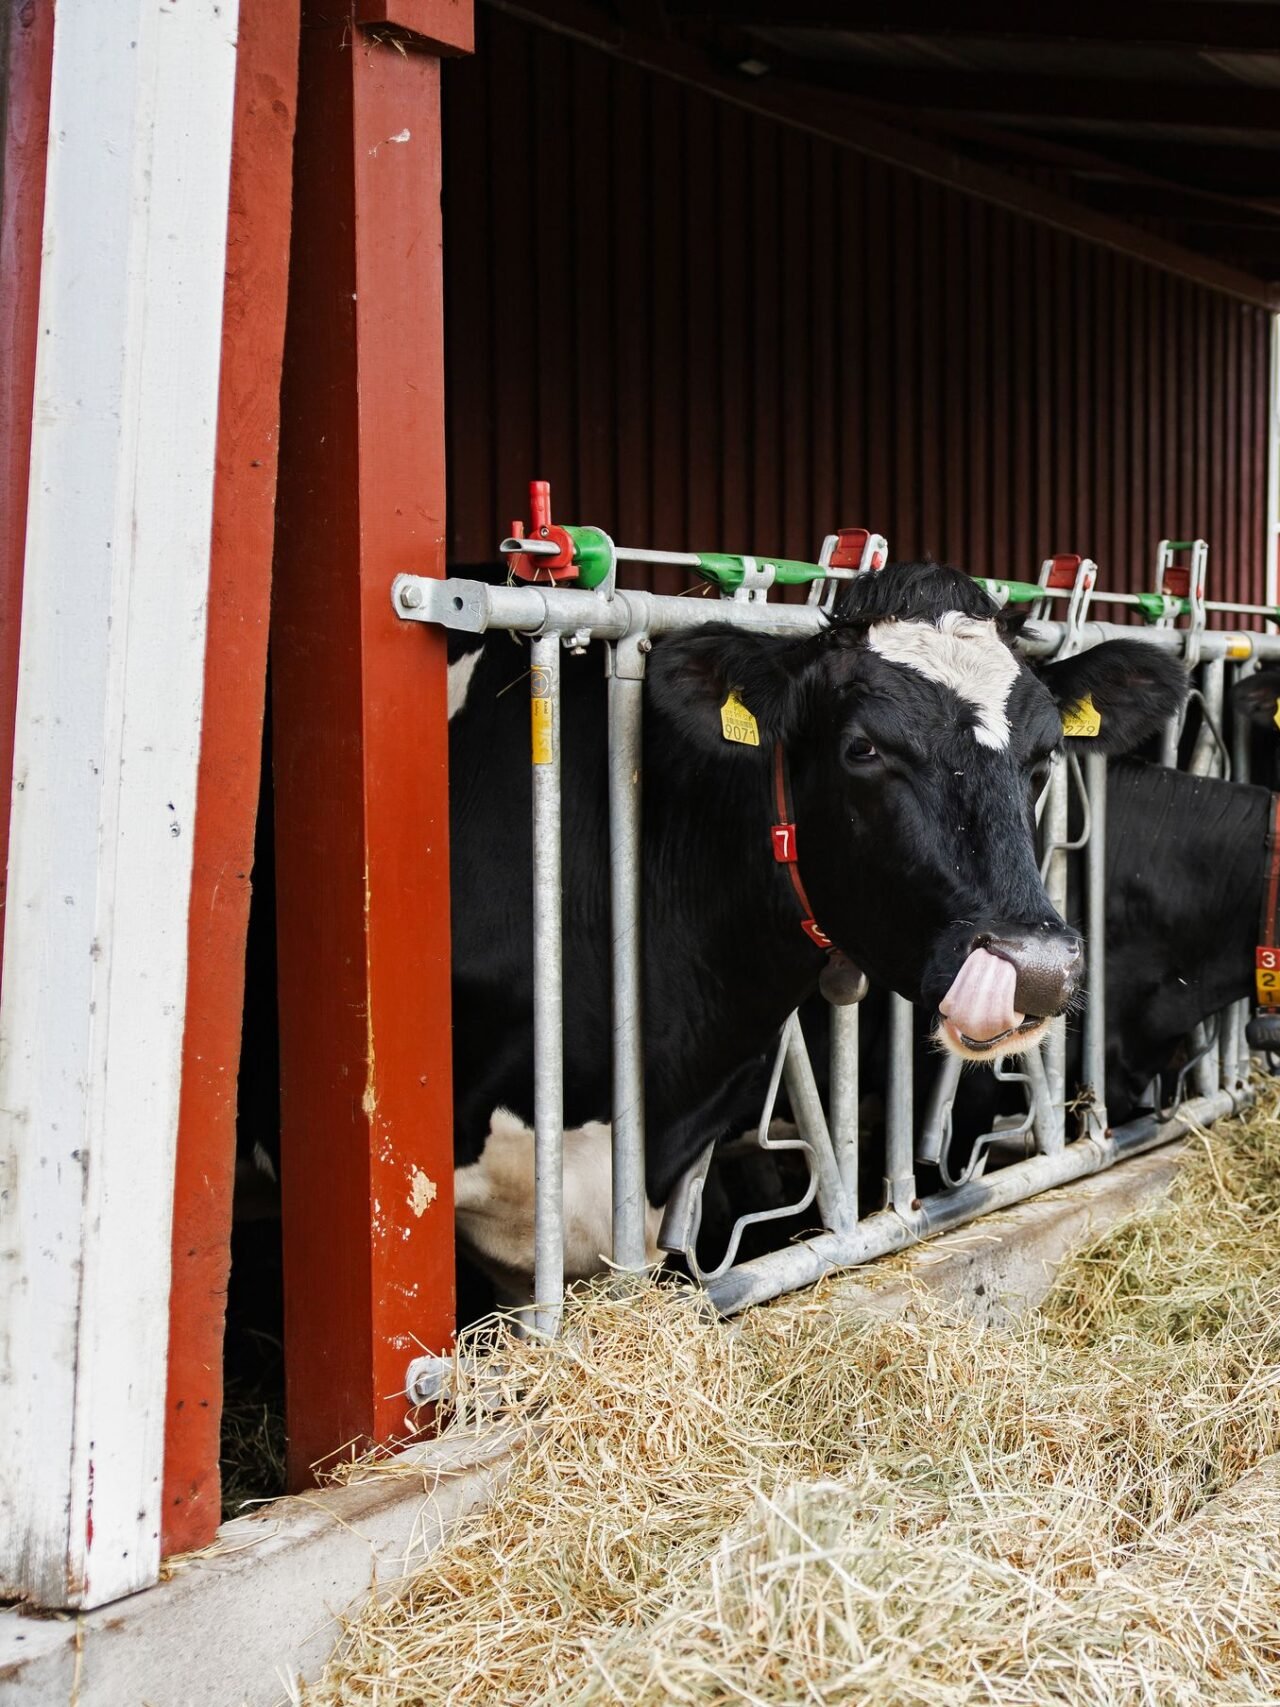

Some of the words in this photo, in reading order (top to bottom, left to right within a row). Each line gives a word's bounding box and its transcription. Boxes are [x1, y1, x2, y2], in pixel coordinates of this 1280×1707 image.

[725, 723, 757, 745] 9071
[775, 830, 789, 858] 7
[1262, 951, 1276, 968] 3
[1262, 973, 1276, 988] 2
[1266, 991, 1273, 1002] 1
